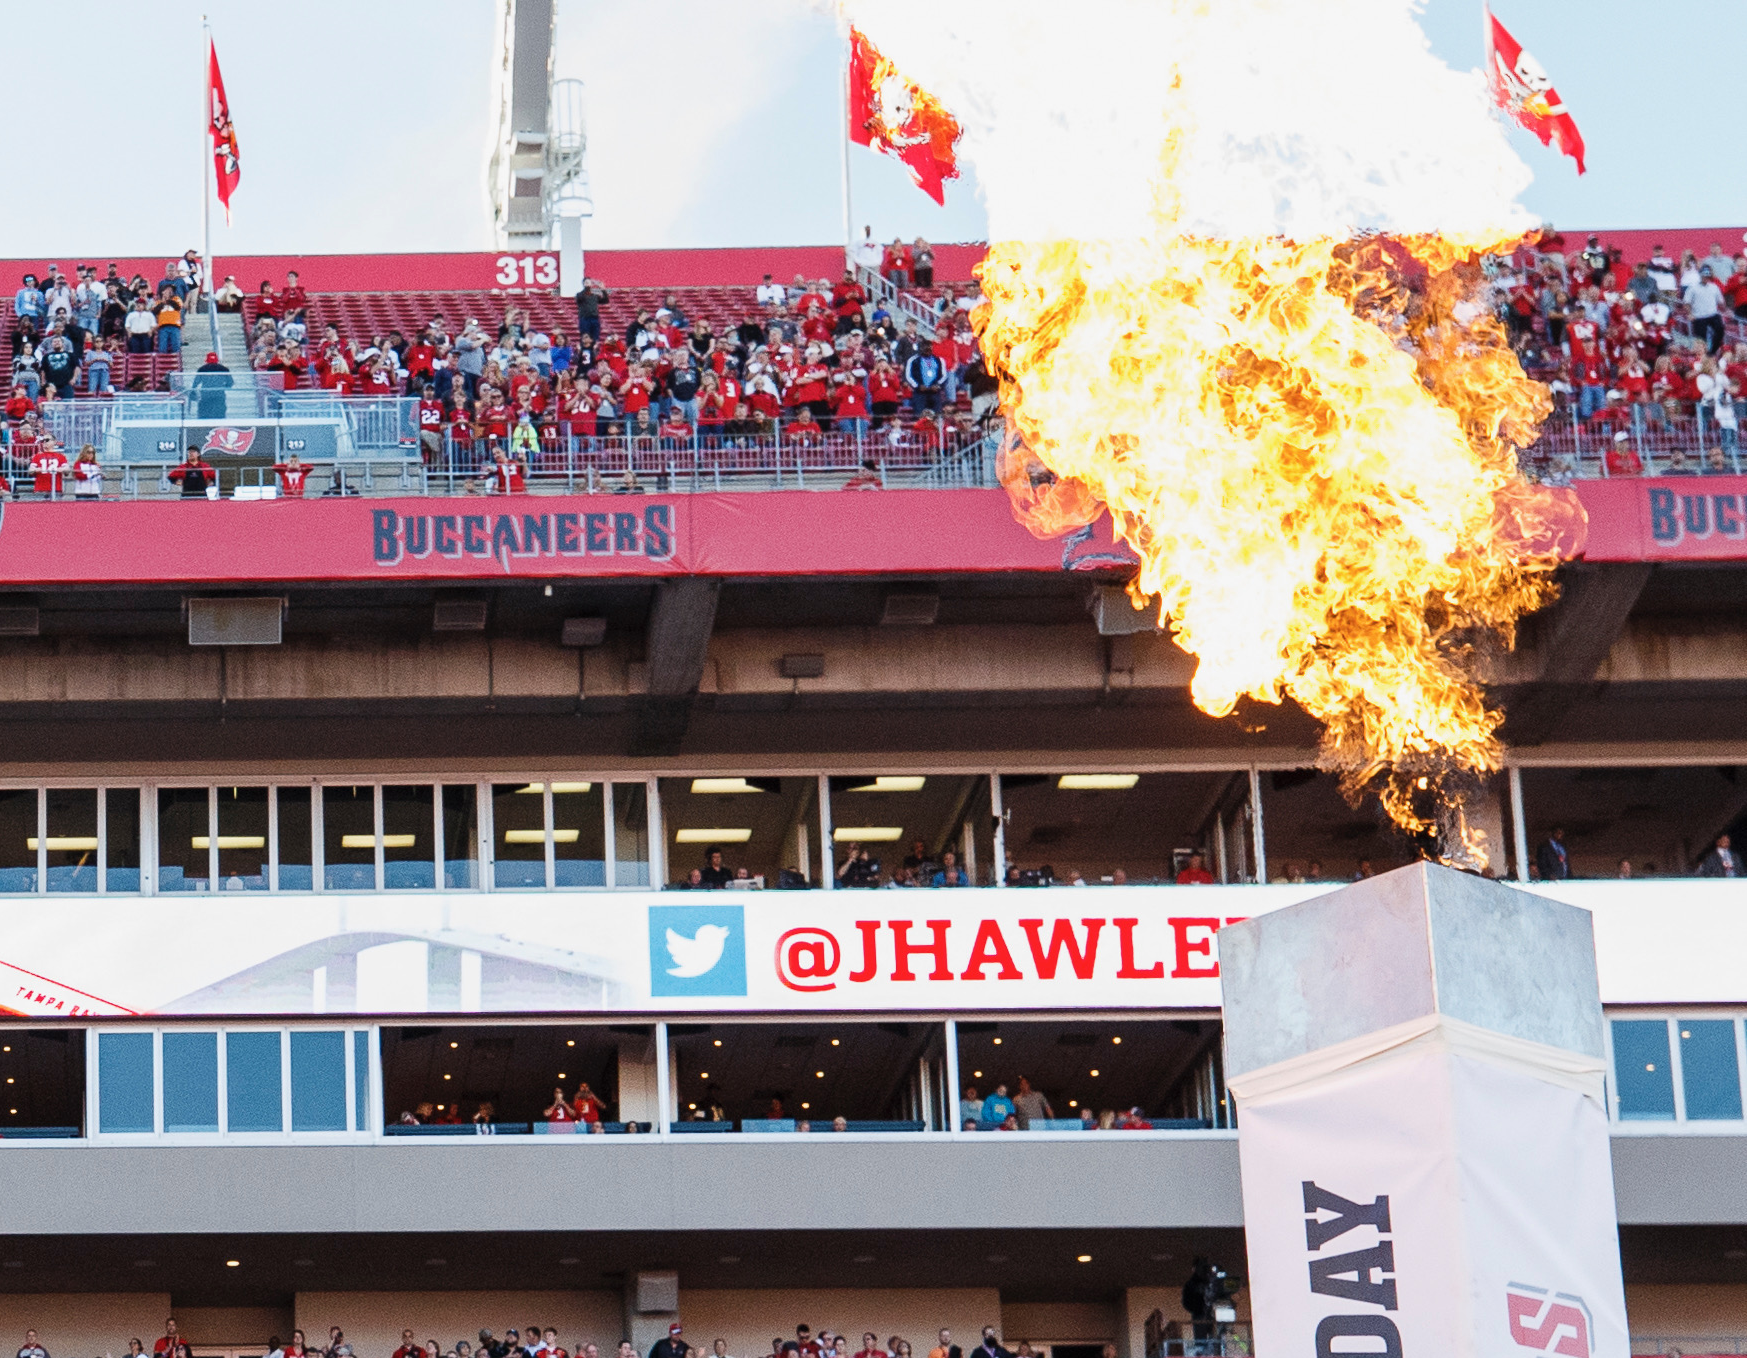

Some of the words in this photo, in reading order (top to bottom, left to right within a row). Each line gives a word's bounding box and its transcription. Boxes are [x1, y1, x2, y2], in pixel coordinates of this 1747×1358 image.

[495, 255, 559, 286] 313
[420, 414, 441, 425] 22
[370, 504, 676, 574] BUCCANEERS
[1647, 487, 1747, 547] BUC
[775, 915, 1252, 993] @JHAWLE
[15, 985, 66, 1011] TAMPA
